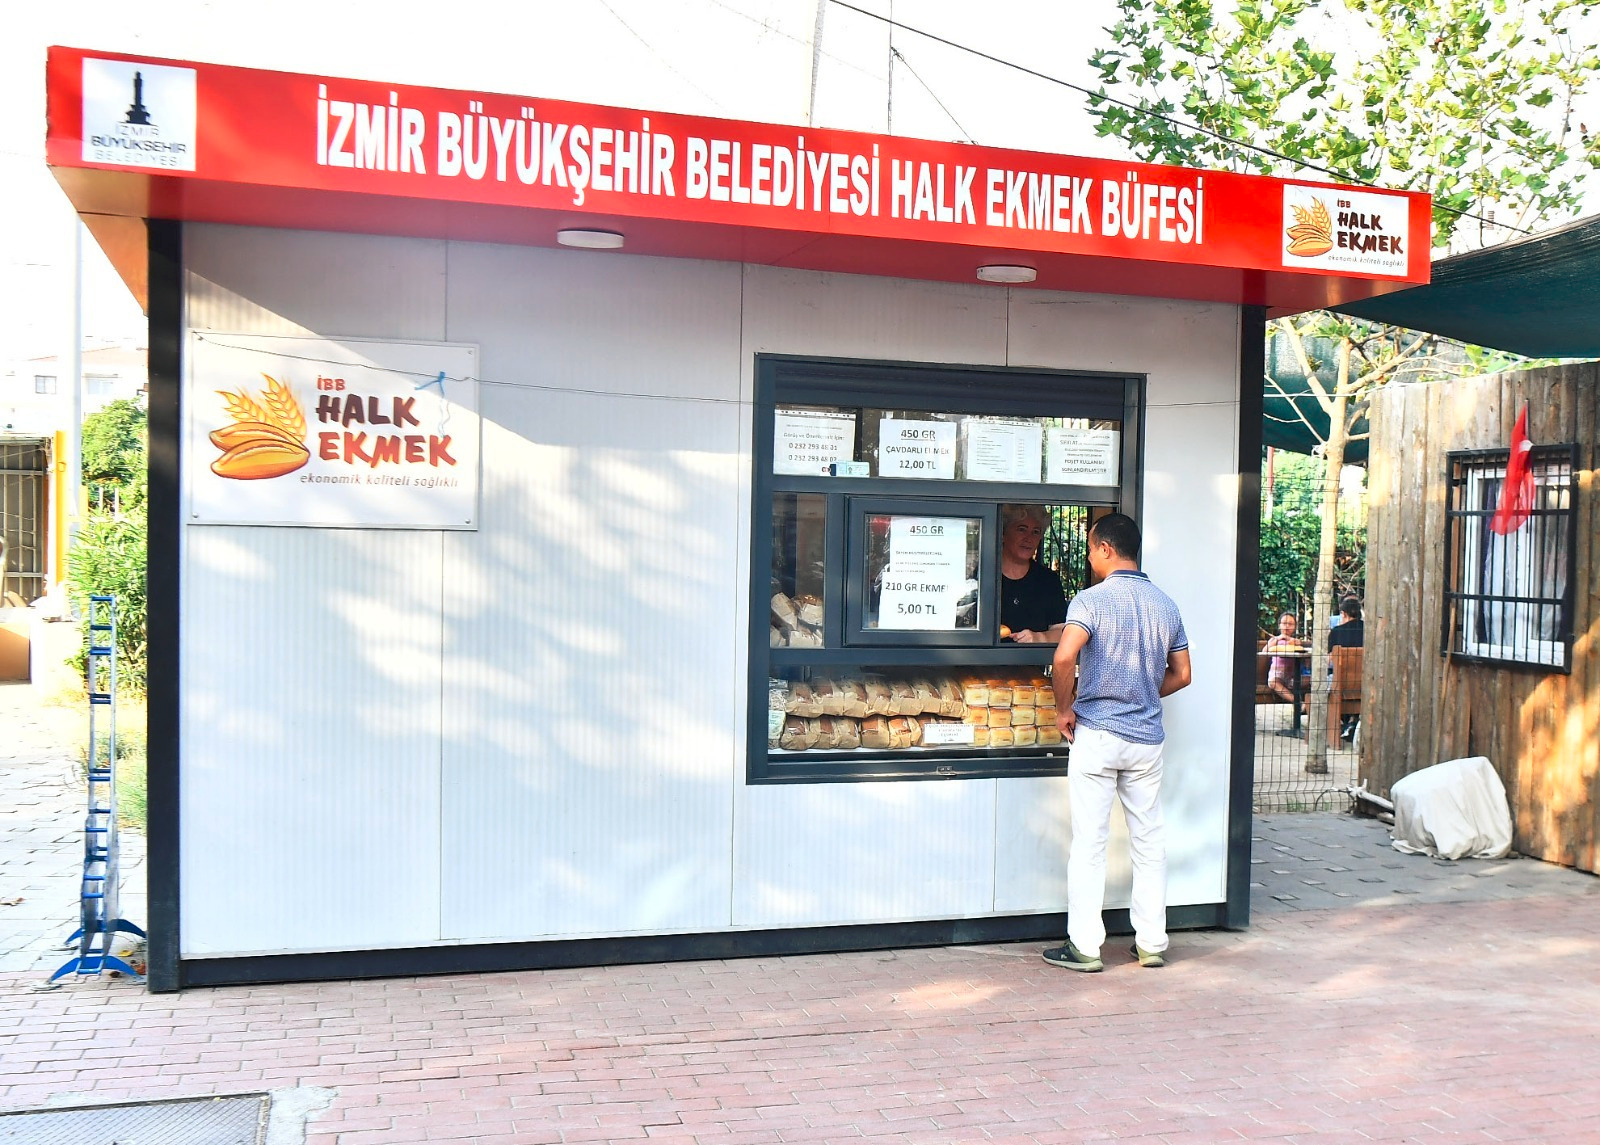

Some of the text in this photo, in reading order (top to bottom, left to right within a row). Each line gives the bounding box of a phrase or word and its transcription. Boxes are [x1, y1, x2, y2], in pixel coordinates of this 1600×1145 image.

[317, 84, 1203, 245] İZMİR BÜYÜKŞEHİR BELEDİYESİ HALK EKMEK BÜFESİ
[1337, 197, 1351, 208] İBB
[1337, 211, 1383, 230] HALK
[1337, 231, 1403, 254] EKMEK
[1328, 255, 1357, 263] ekonomik
[317, 374, 346, 391] İBB
[316, 393, 420, 428] HALK
[900, 429, 936, 439] 450 GR
[318, 431, 457, 468] EKMEK
[885, 445, 923, 454] ÇAVDARLI
[900, 460, 936, 470] 12,00 TL
[300, 473, 361, 485] ekonomik
[366, 474, 410, 486] kaliteli
[909, 525, 944, 534] 450 GR
[885, 582, 902, 591] 210
[904, 582, 918, 592] GR
[897, 603, 937, 616] 5,00 TL
